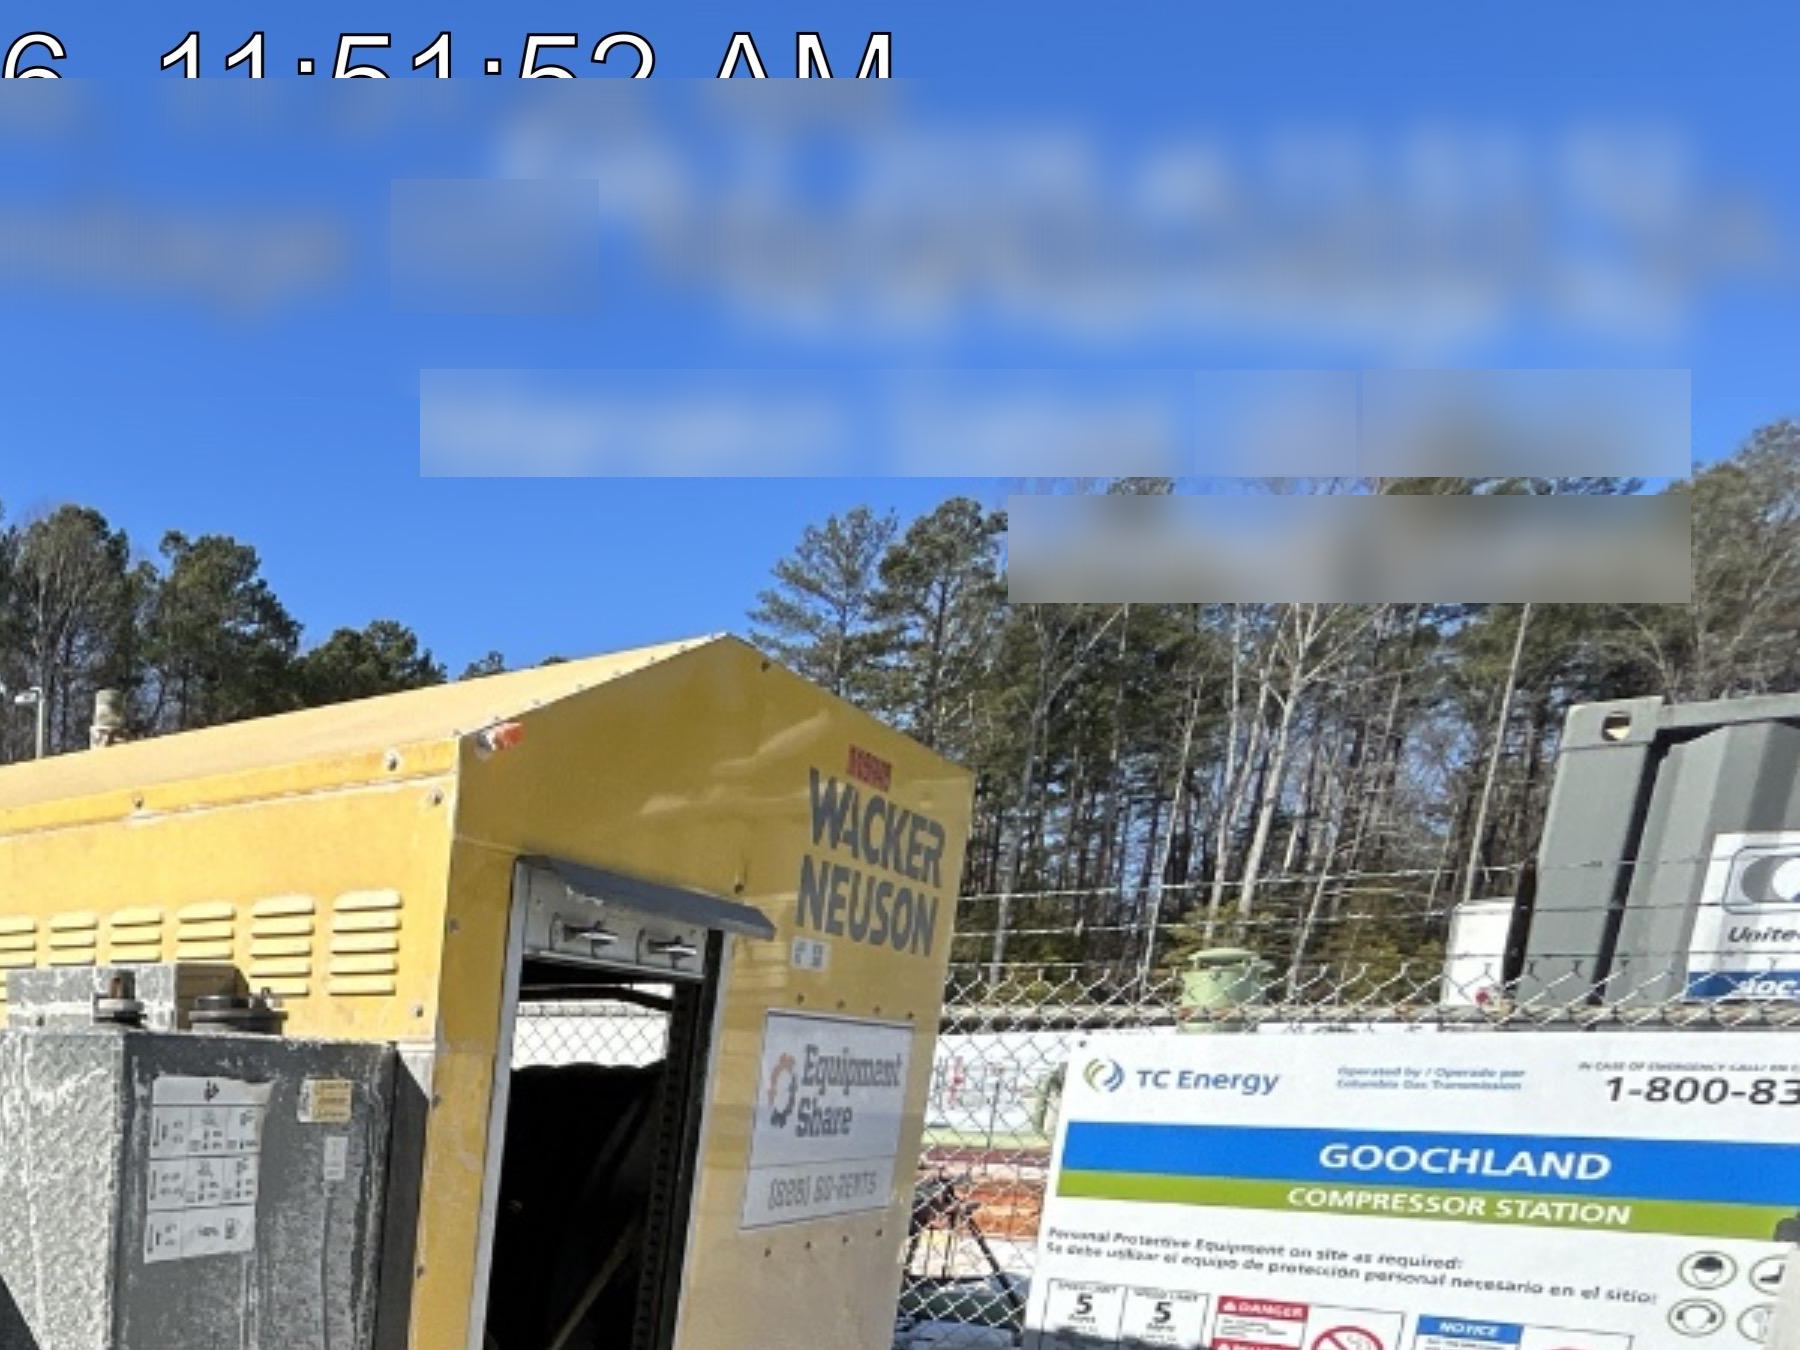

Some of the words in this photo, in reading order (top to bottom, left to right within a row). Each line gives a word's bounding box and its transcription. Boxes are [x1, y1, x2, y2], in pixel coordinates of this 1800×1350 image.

[808, 766, 945, 888] WACKER
[795, 854, 939, 957] NEUSON
[1728, 926, 1800, 943] Unite
[802, 1044, 903, 1096] Equipment
[1136, 1070, 1170, 1088] TC
[1176, 1070, 1279, 1095] Energy
[795, 1098, 853, 1137] Share
[1319, 1142, 1612, 1181] GOOCHLAND
[1287, 1187, 1486, 1217] COMPRESSOR
[1496, 1199, 1632, 1226] STATION
[1196, 1238, 1285, 1258] Equipment
[1289, 1247, 1312, 1259] on
[1316, 1247, 1348, 1261] site
[1353, 1252, 1372, 1264] as
[1181, 1256, 1239, 1271] equipo
[1242, 1258, 1264, 1271] de
[1363, 1270, 1446, 1287] personal
[1450, 1276, 1543, 1295] necesario
[1549, 1286, 1576, 1298] en
[1076, 1293, 1093, 1315] 5
[1153, 1301, 1173, 1324] 5
[1439, 1322, 1499, 1337] NOTICE
